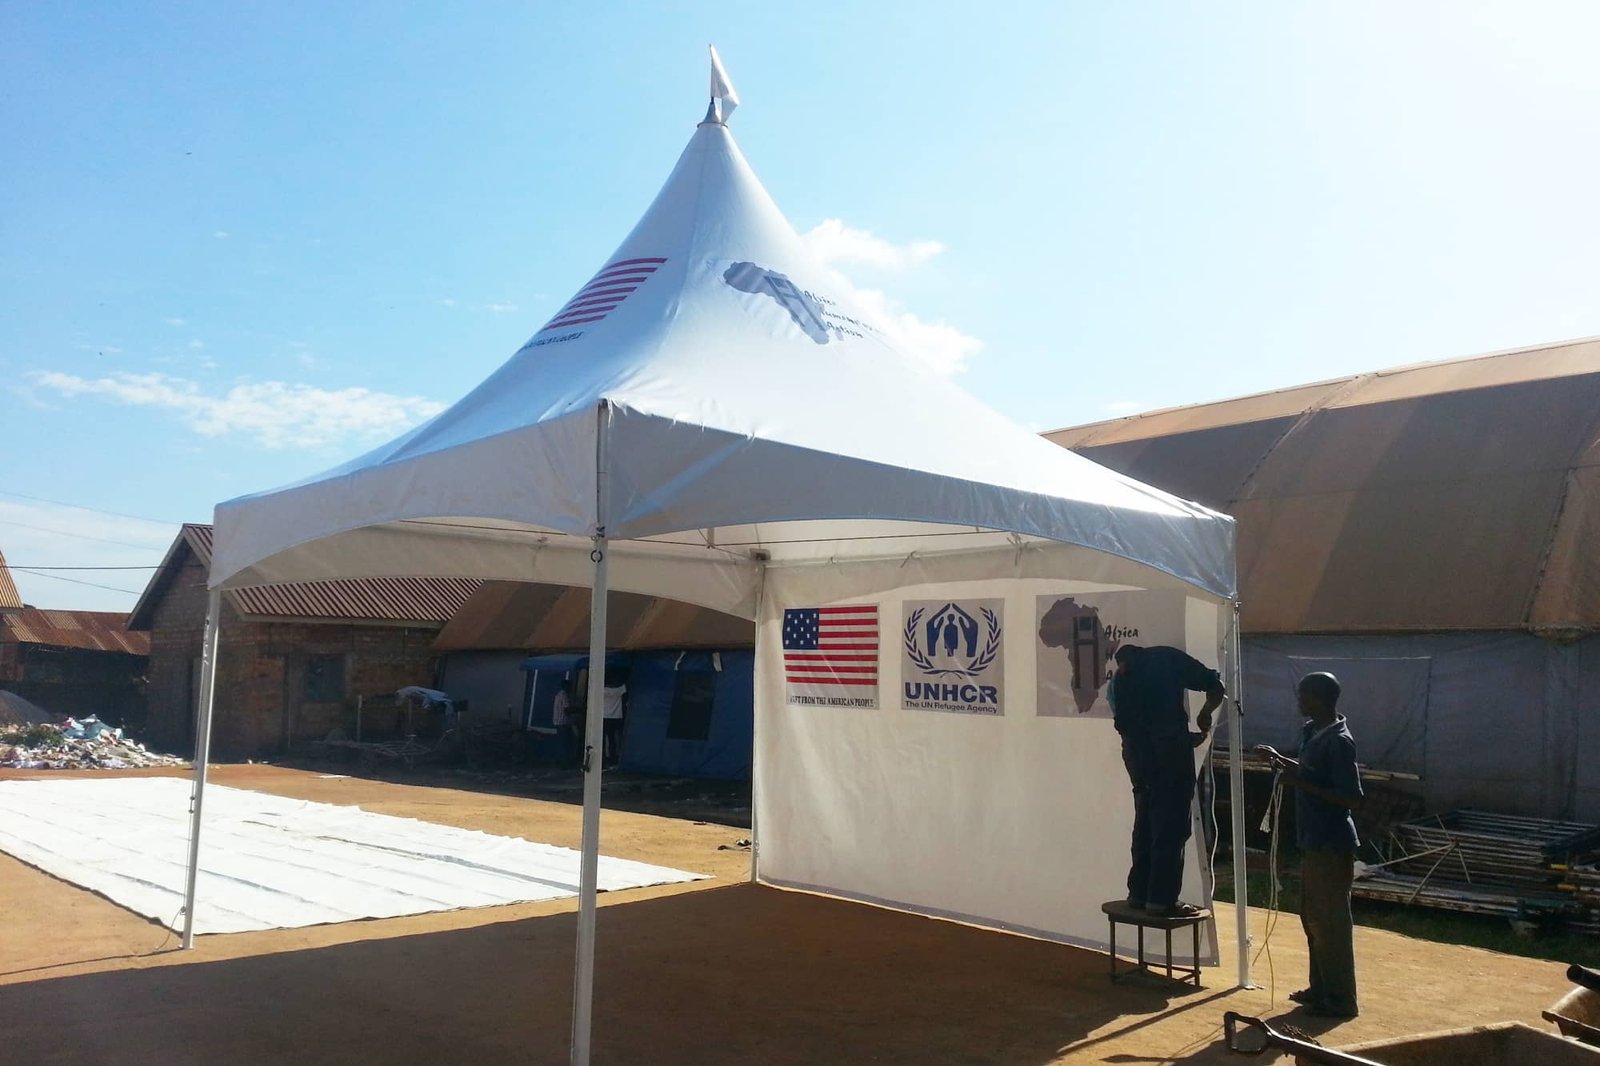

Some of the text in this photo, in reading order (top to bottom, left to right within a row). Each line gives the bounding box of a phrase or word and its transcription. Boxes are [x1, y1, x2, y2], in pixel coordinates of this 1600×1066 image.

[1104, 624, 1139, 641] Africa
[905, 682, 998, 704] UNHCR
[816, 697, 826, 705] THE
[828, 697, 855, 706] AMERICAN
[921, 701, 933, 709] UN
[934, 702, 966, 711] Refugee
[967, 704, 998, 713] Agency
